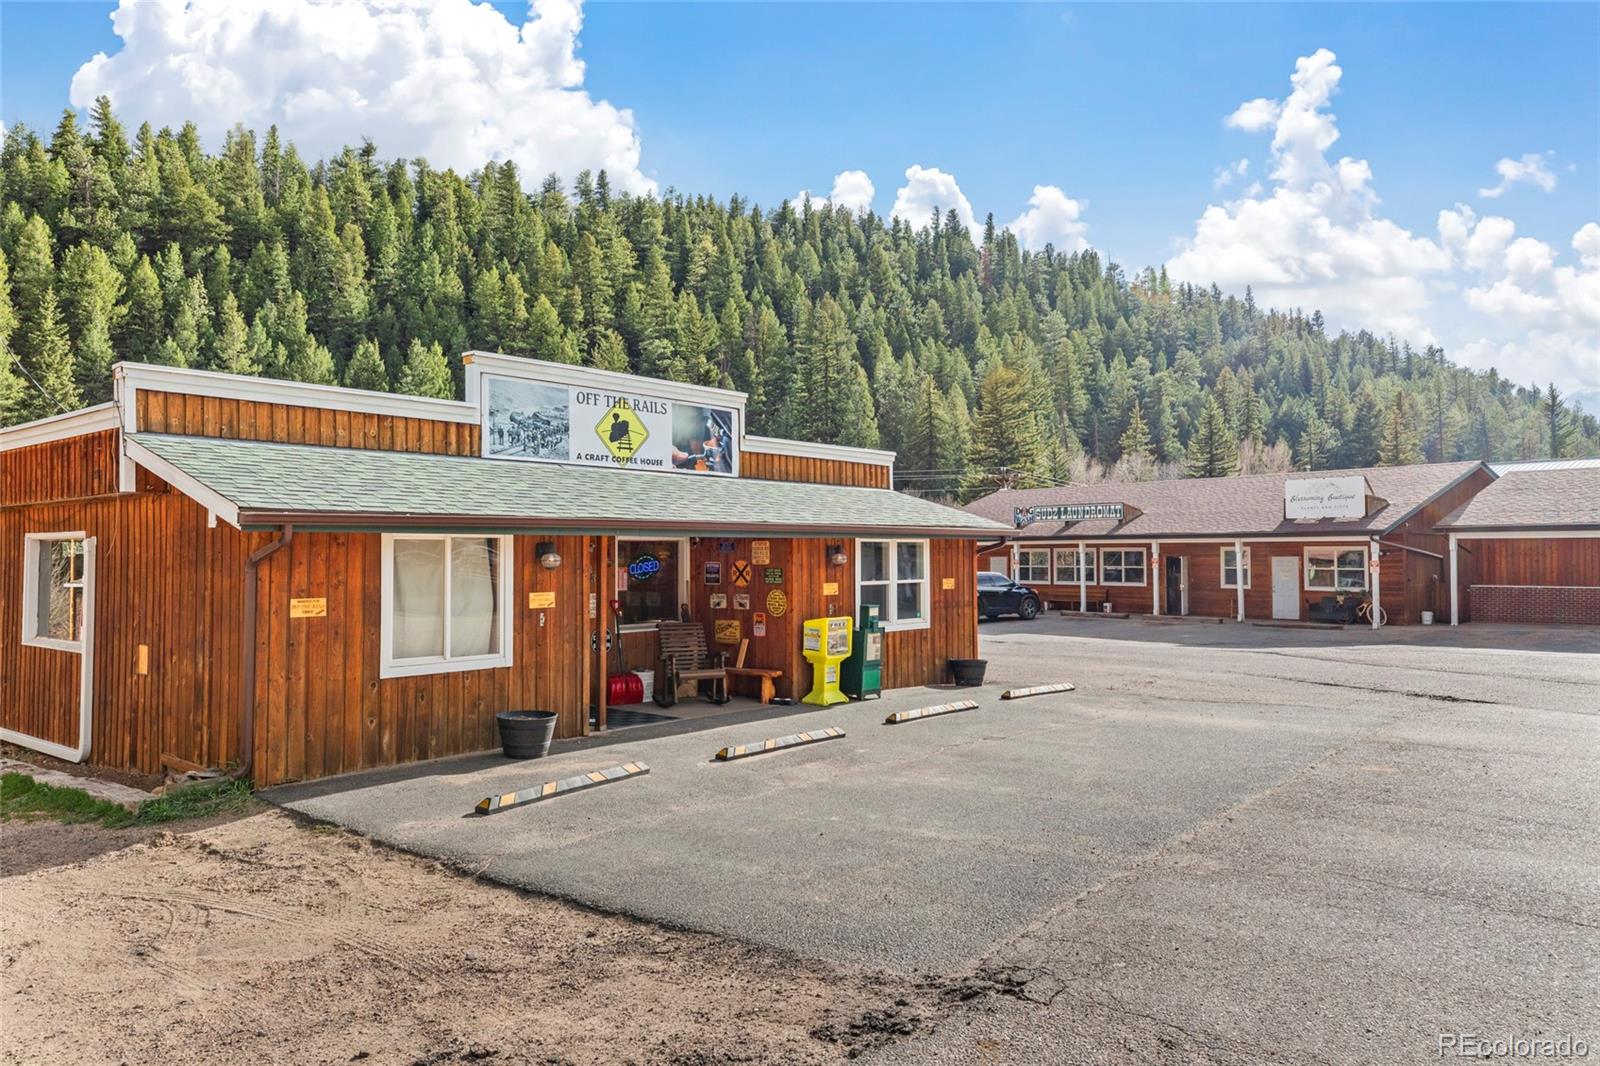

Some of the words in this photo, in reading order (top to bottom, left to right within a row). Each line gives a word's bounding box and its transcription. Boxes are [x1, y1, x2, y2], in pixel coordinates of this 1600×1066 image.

[576, 391, 601, 406] OFF
[604, 395, 629, 410] THE
[633, 398, 668, 415] RAILS
[585, 453, 609, 462] CRAFT
[611, 456, 638, 464] COFFEE
[640, 458, 664, 466] HOUSE
[1035, 507, 1059, 519] SUDZ
[1060, 505, 1122, 519] LAUNDROMAT
[629, 560, 660, 575] CLOSED
